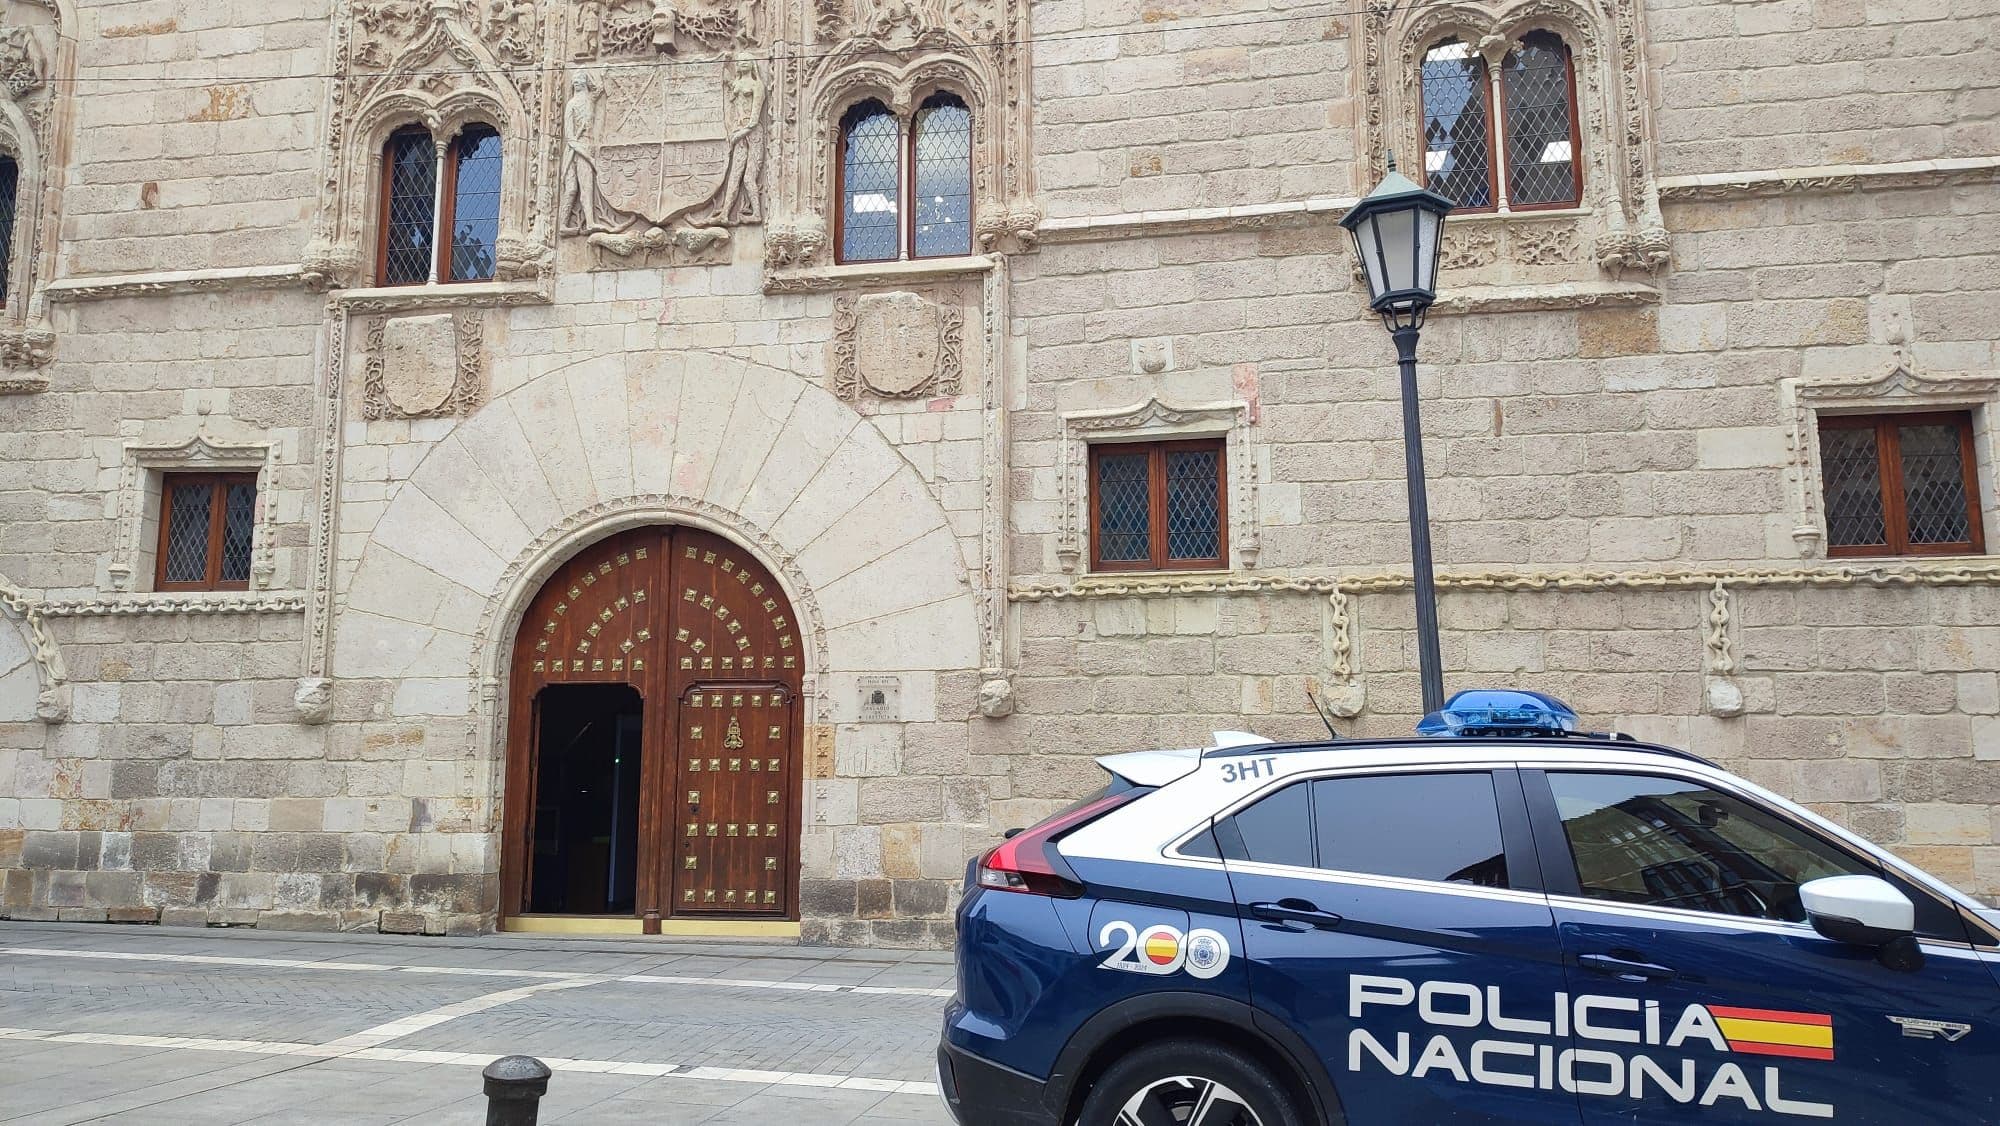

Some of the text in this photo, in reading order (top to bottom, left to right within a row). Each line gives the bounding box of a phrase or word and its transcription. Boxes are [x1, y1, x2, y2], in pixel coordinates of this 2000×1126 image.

[1221, 757, 1278, 783] 3HT
[1096, 920, 1230, 979] 200
[1348, 1028, 1834, 1118] NACIONAL
